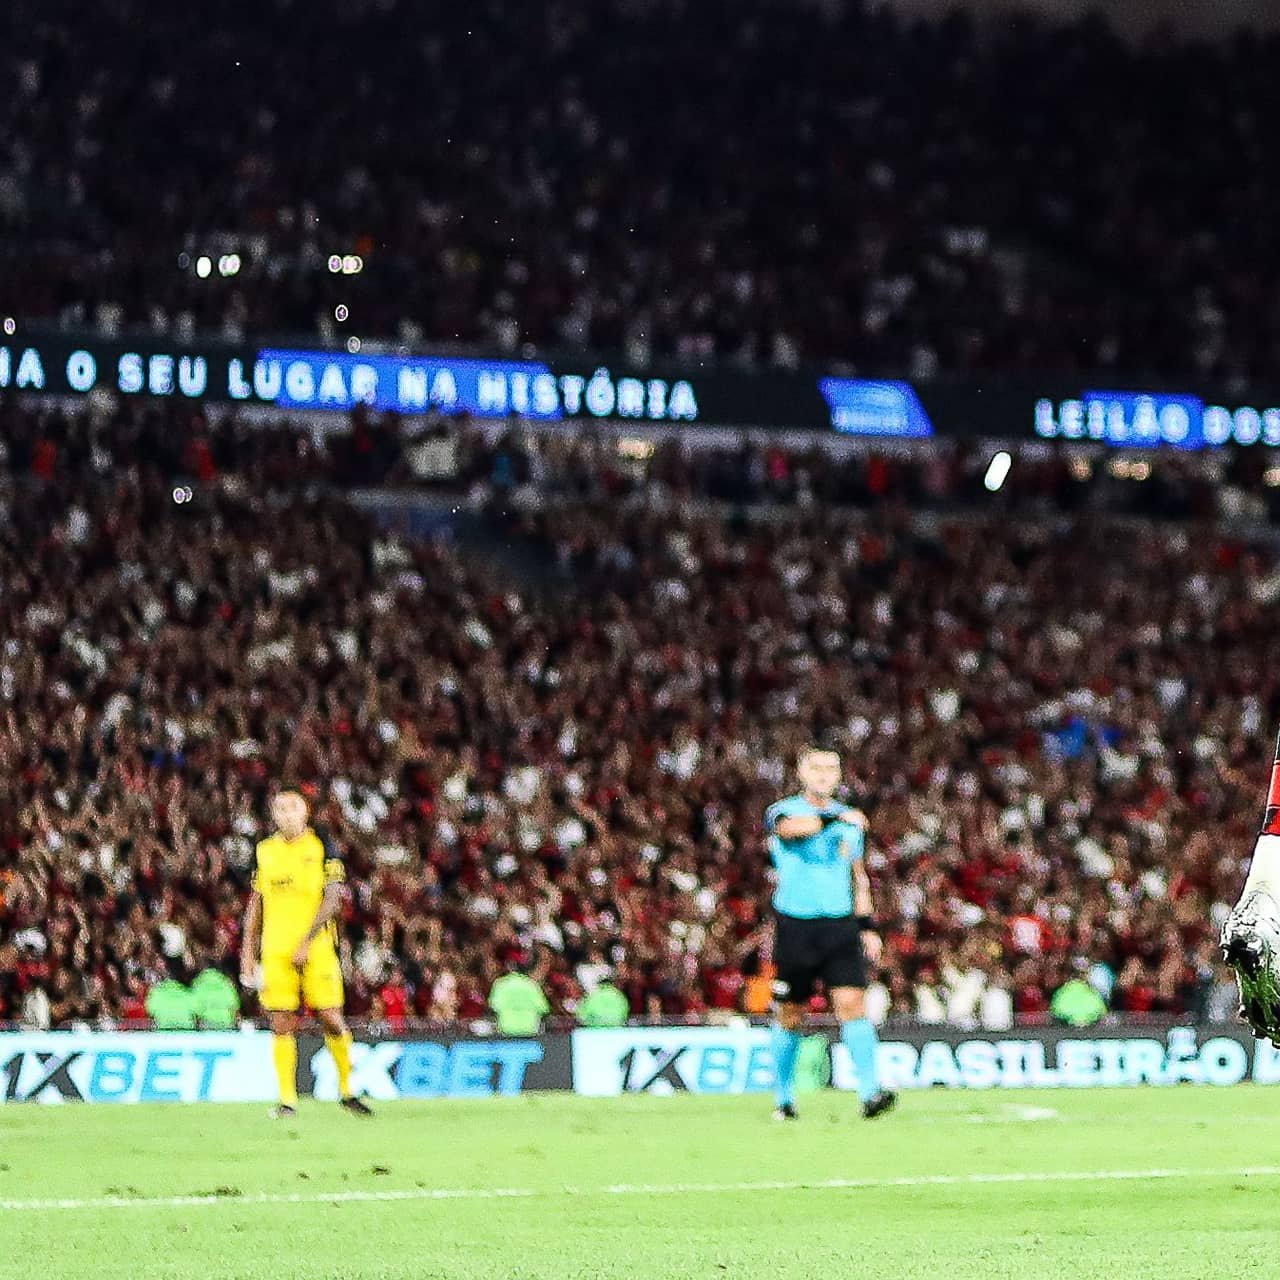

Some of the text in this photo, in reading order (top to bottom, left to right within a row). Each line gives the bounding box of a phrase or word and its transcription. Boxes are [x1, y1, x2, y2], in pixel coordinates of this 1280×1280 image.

[66, 349, 97, 392] O
[118, 352, 207, 398] SEU
[228, 357, 378, 404] LUGAR
[398, 366, 457, 412] NA
[477, 367, 698, 420] HISTÓRIA
[1034, 395, 1190, 444] LEILÃO
[2, 1050, 233, 1103] 1XBET
[619, 1046, 792, 1093] 1XBE
